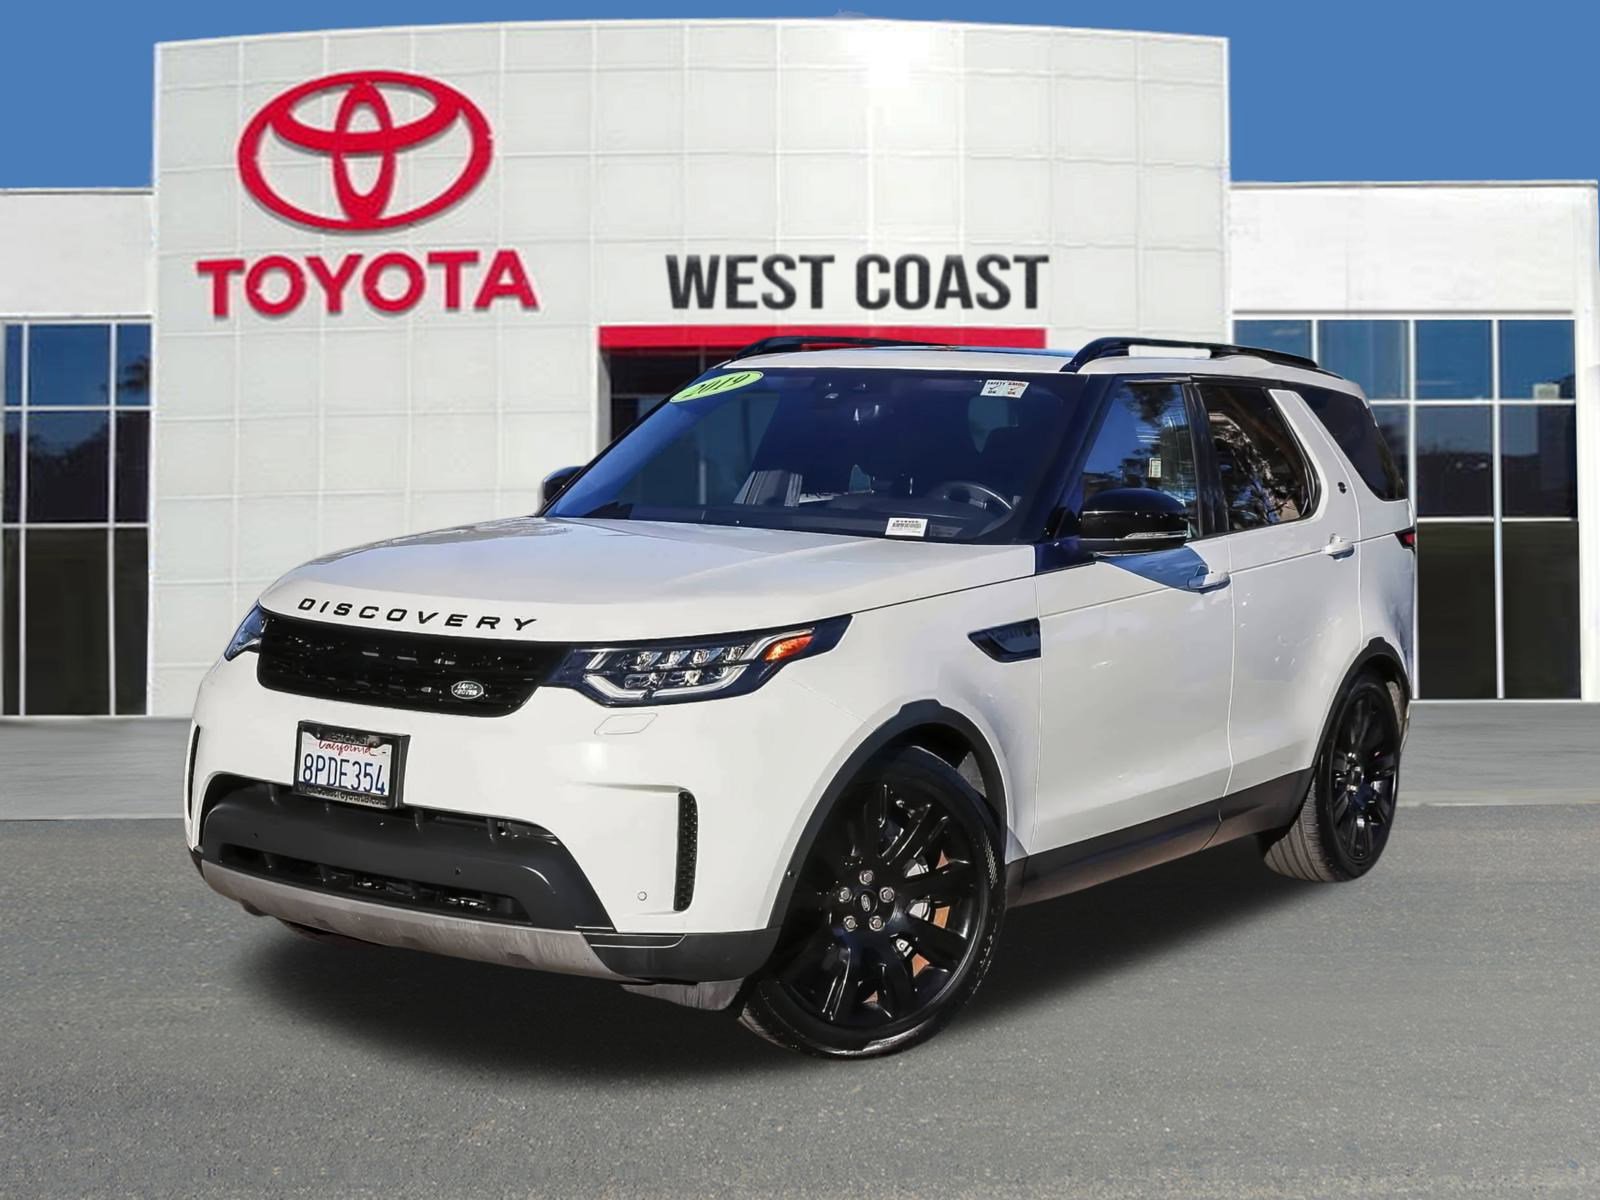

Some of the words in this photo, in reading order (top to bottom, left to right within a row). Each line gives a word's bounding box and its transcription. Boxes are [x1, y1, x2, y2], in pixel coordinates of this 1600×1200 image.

[196, 249, 539, 317] TOYOTA
[666, 254, 835, 310] WEST
[855, 253, 1050, 310] COAST
[681, 373, 751, 399] 2019
[298, 598, 537, 631] DISCOVERY
[303, 753, 385, 795] 8PDE354
